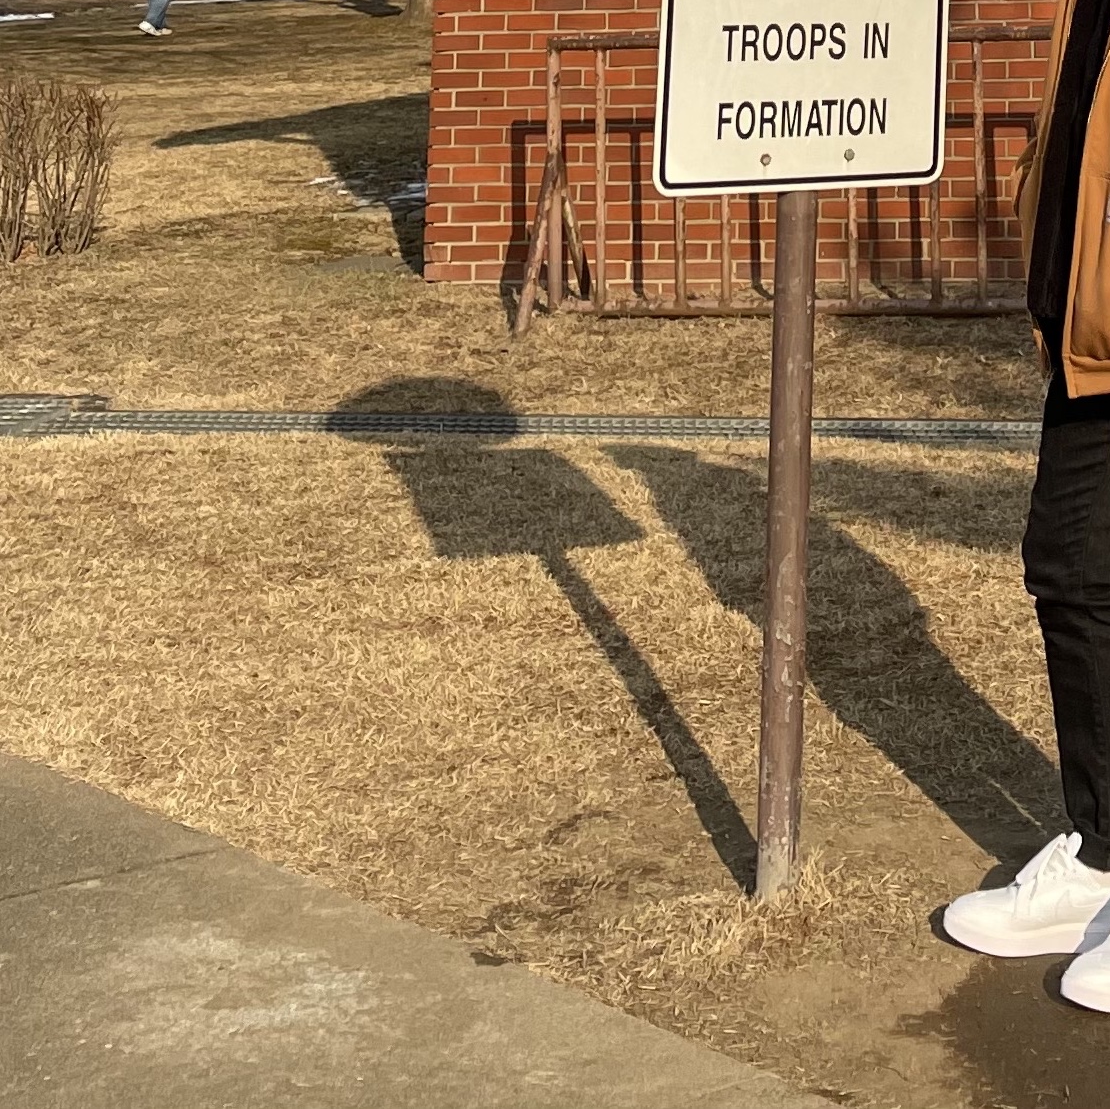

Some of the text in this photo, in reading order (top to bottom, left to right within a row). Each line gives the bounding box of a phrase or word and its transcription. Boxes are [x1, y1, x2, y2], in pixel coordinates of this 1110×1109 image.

[722, 22, 890, 62] TROOPS IN
[717, 97, 887, 140] FORMATION
